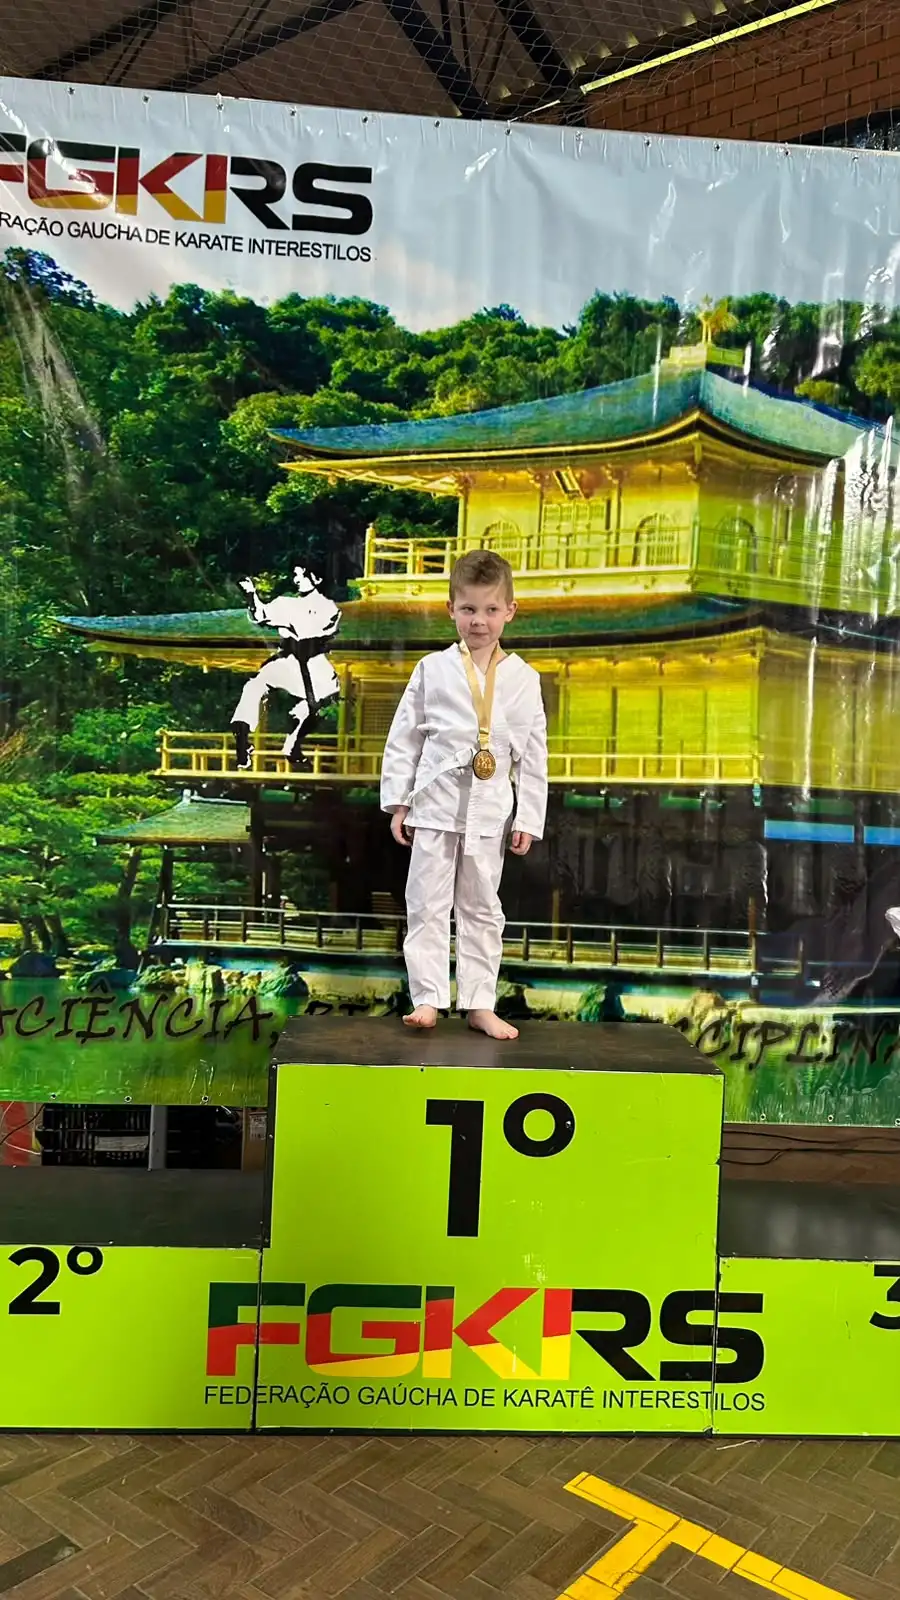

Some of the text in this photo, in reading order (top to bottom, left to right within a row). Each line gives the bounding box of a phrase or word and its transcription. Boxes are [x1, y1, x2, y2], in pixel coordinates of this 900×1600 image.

[146, 229, 171, 246] DE
[174, 232, 243, 254] KARATE
[248, 238, 372, 263] INTERESTILOS
[204, 1382, 766, 1412] FEDERAÇÃO GAÚCHA DE KARATÊ INTERESTILOS
